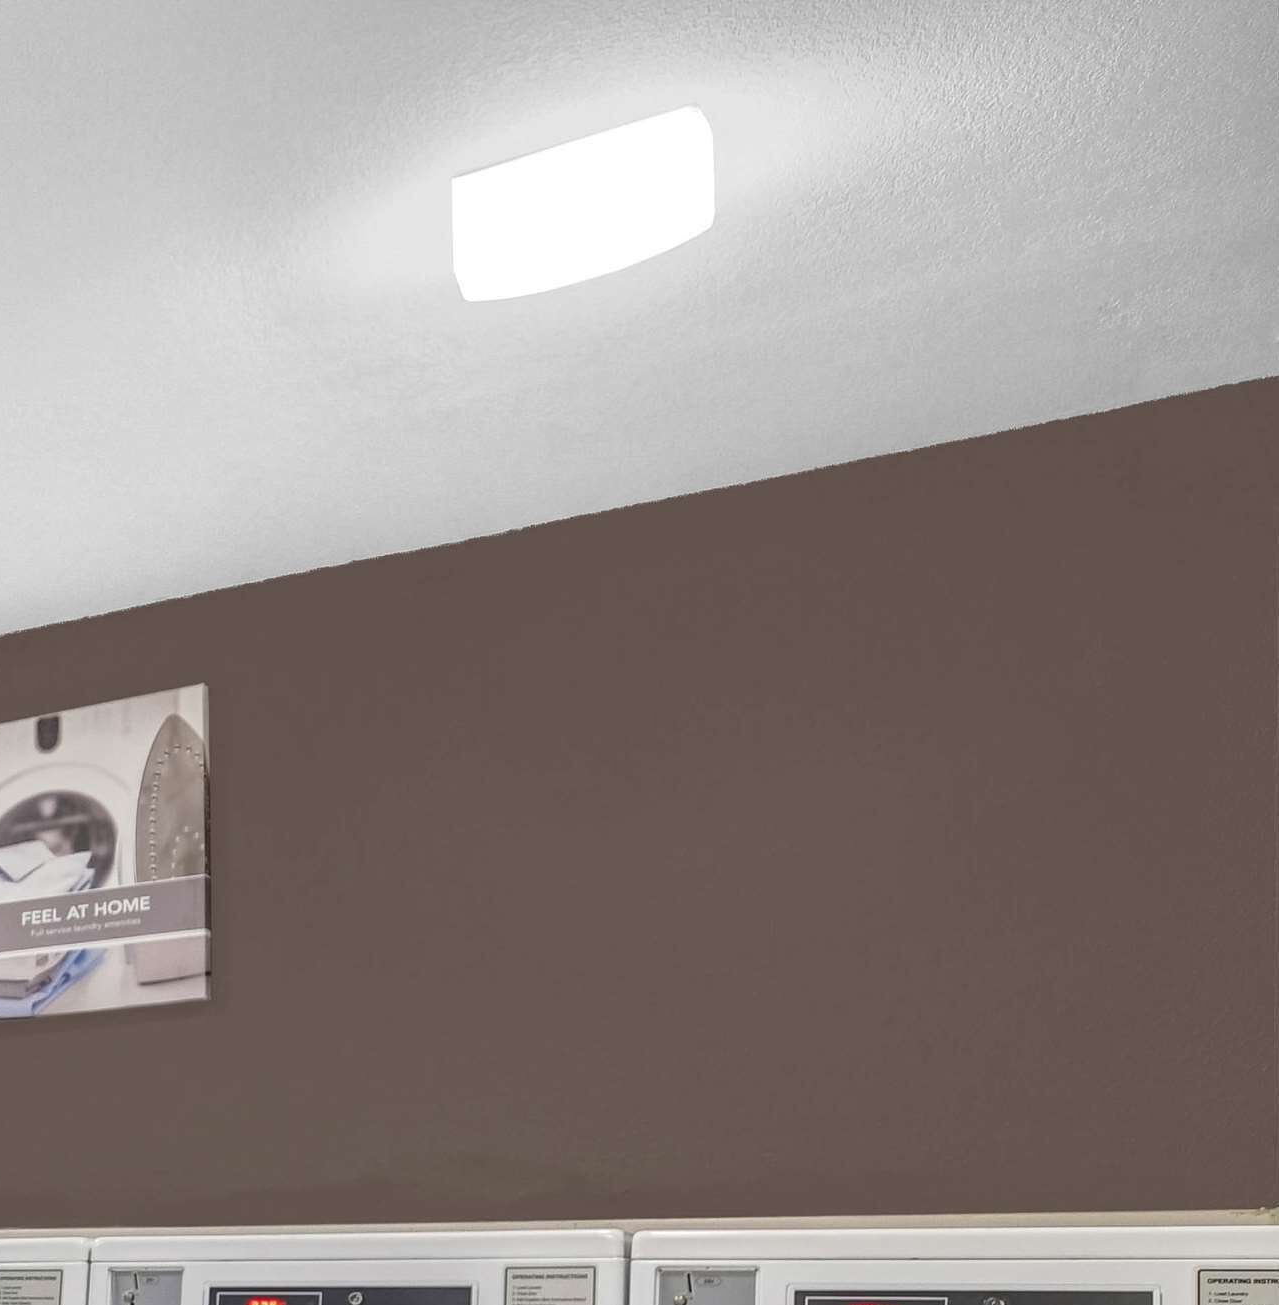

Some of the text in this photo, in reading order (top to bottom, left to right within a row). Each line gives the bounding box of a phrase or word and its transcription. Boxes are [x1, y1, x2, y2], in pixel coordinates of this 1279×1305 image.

[21, 896, 151, 926] FEEL AT HOME
[31, 918, 141, 937] Full service laundry amenities
